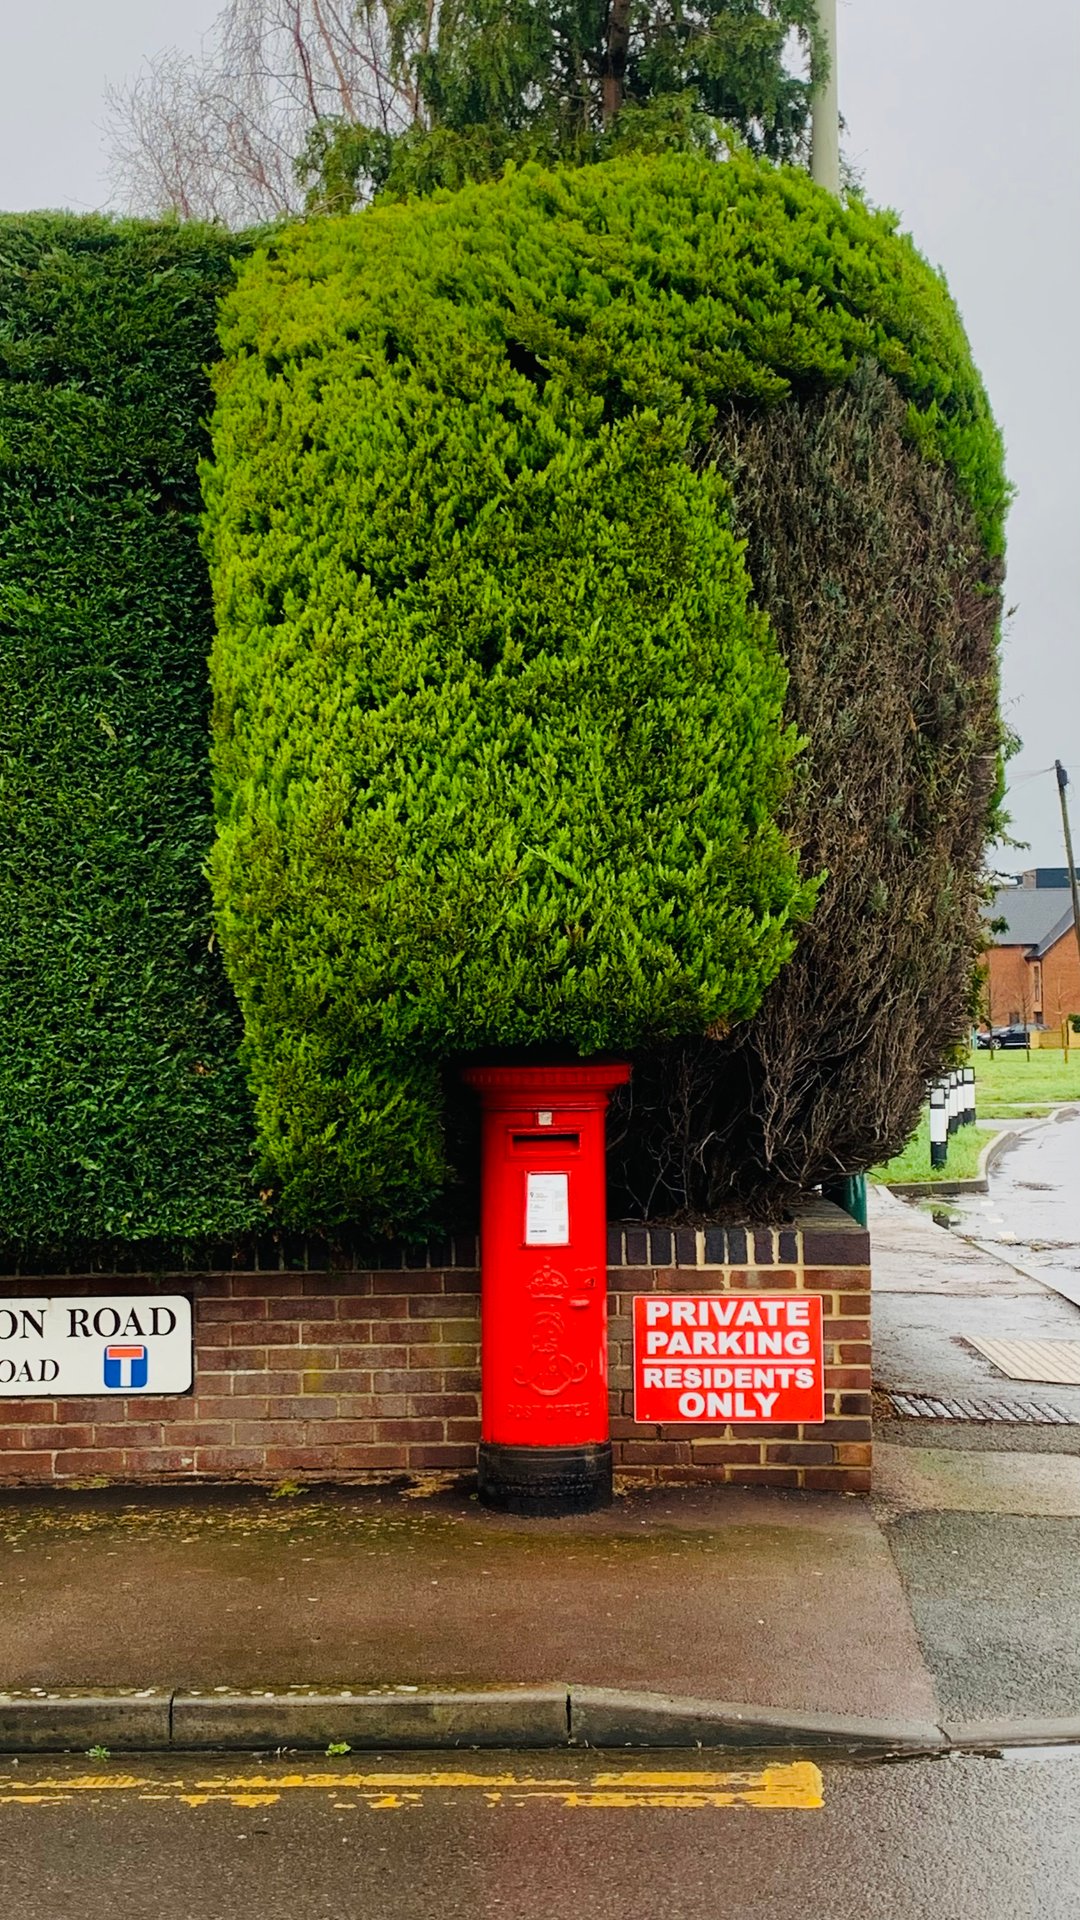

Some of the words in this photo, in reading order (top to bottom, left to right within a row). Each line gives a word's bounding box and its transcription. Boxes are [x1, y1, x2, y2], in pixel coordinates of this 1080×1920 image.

[0, 1309, 47, 1339] ON
[66, 1307, 177, 1338] ROAD
[645, 1301, 810, 1326] PRIVATE
[646, 1331, 810, 1355] PARKING
[0, 1359, 60, 1383] OAD
[643, 1367, 814, 1389] RESIDENTS
[678, 1391, 780, 1418] ONLY
